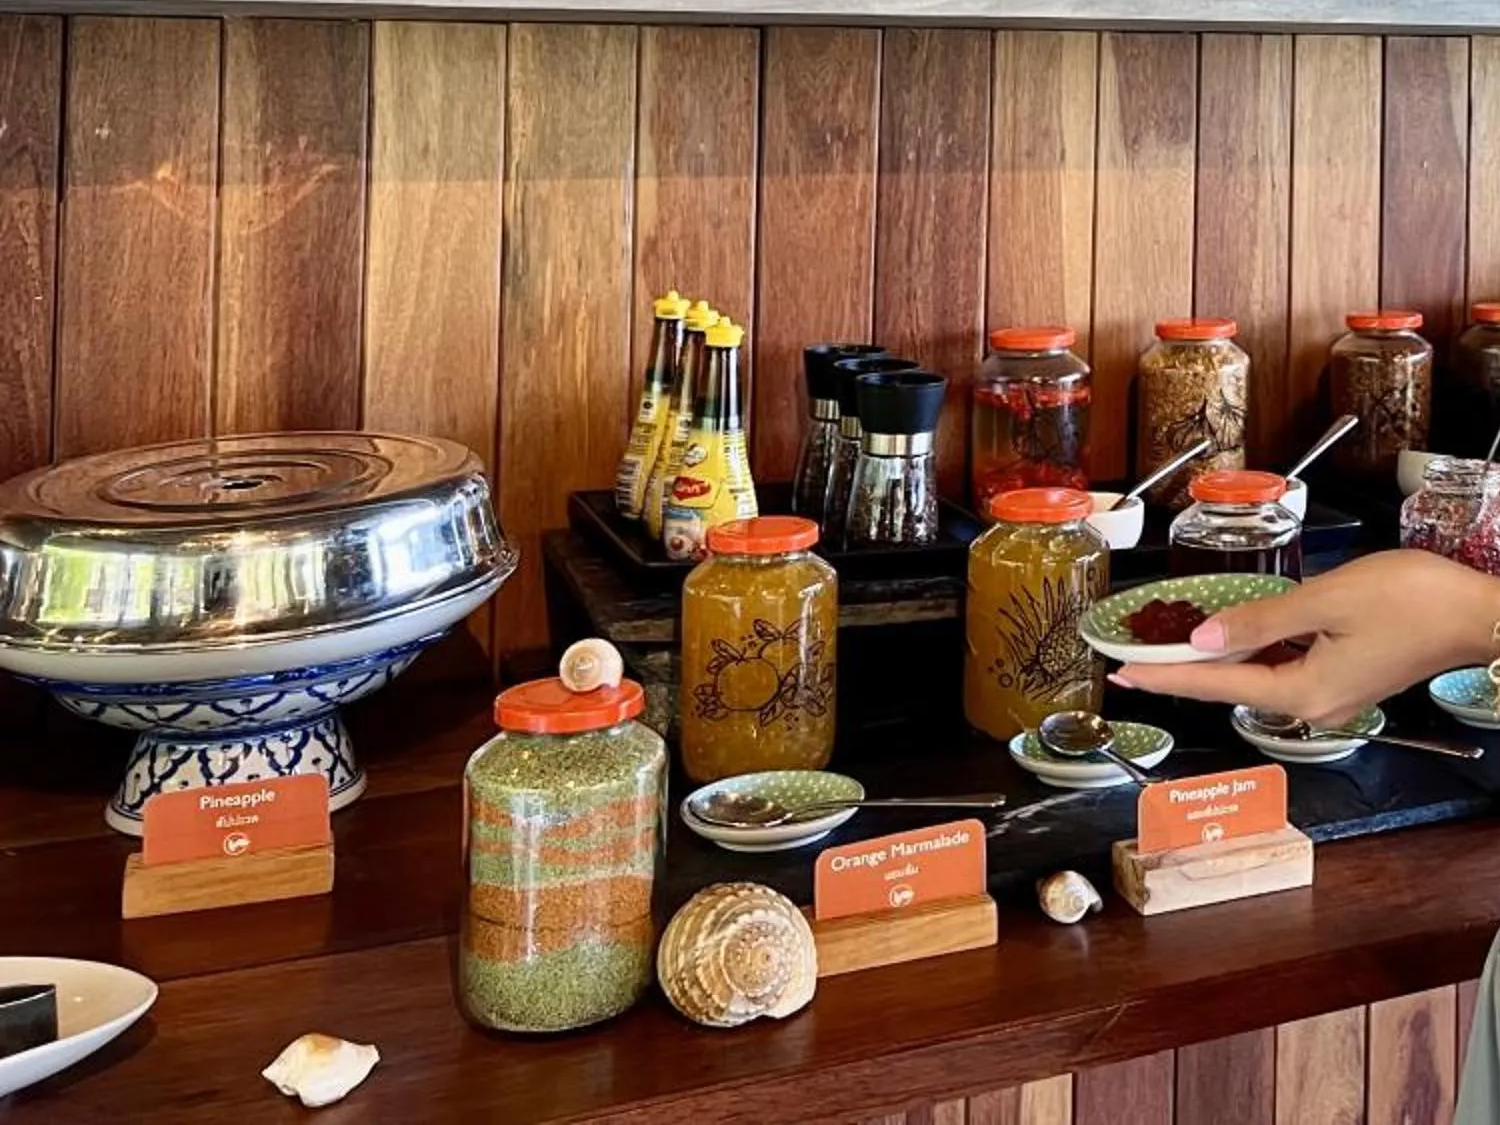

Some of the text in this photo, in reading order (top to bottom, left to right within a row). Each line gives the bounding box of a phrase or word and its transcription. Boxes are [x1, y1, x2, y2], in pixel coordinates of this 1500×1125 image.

[199, 788, 276, 810] Pineapple
[1168, 779, 1257, 804] Pineapple Jam
[831, 830, 971, 873] Orange Marmalade
